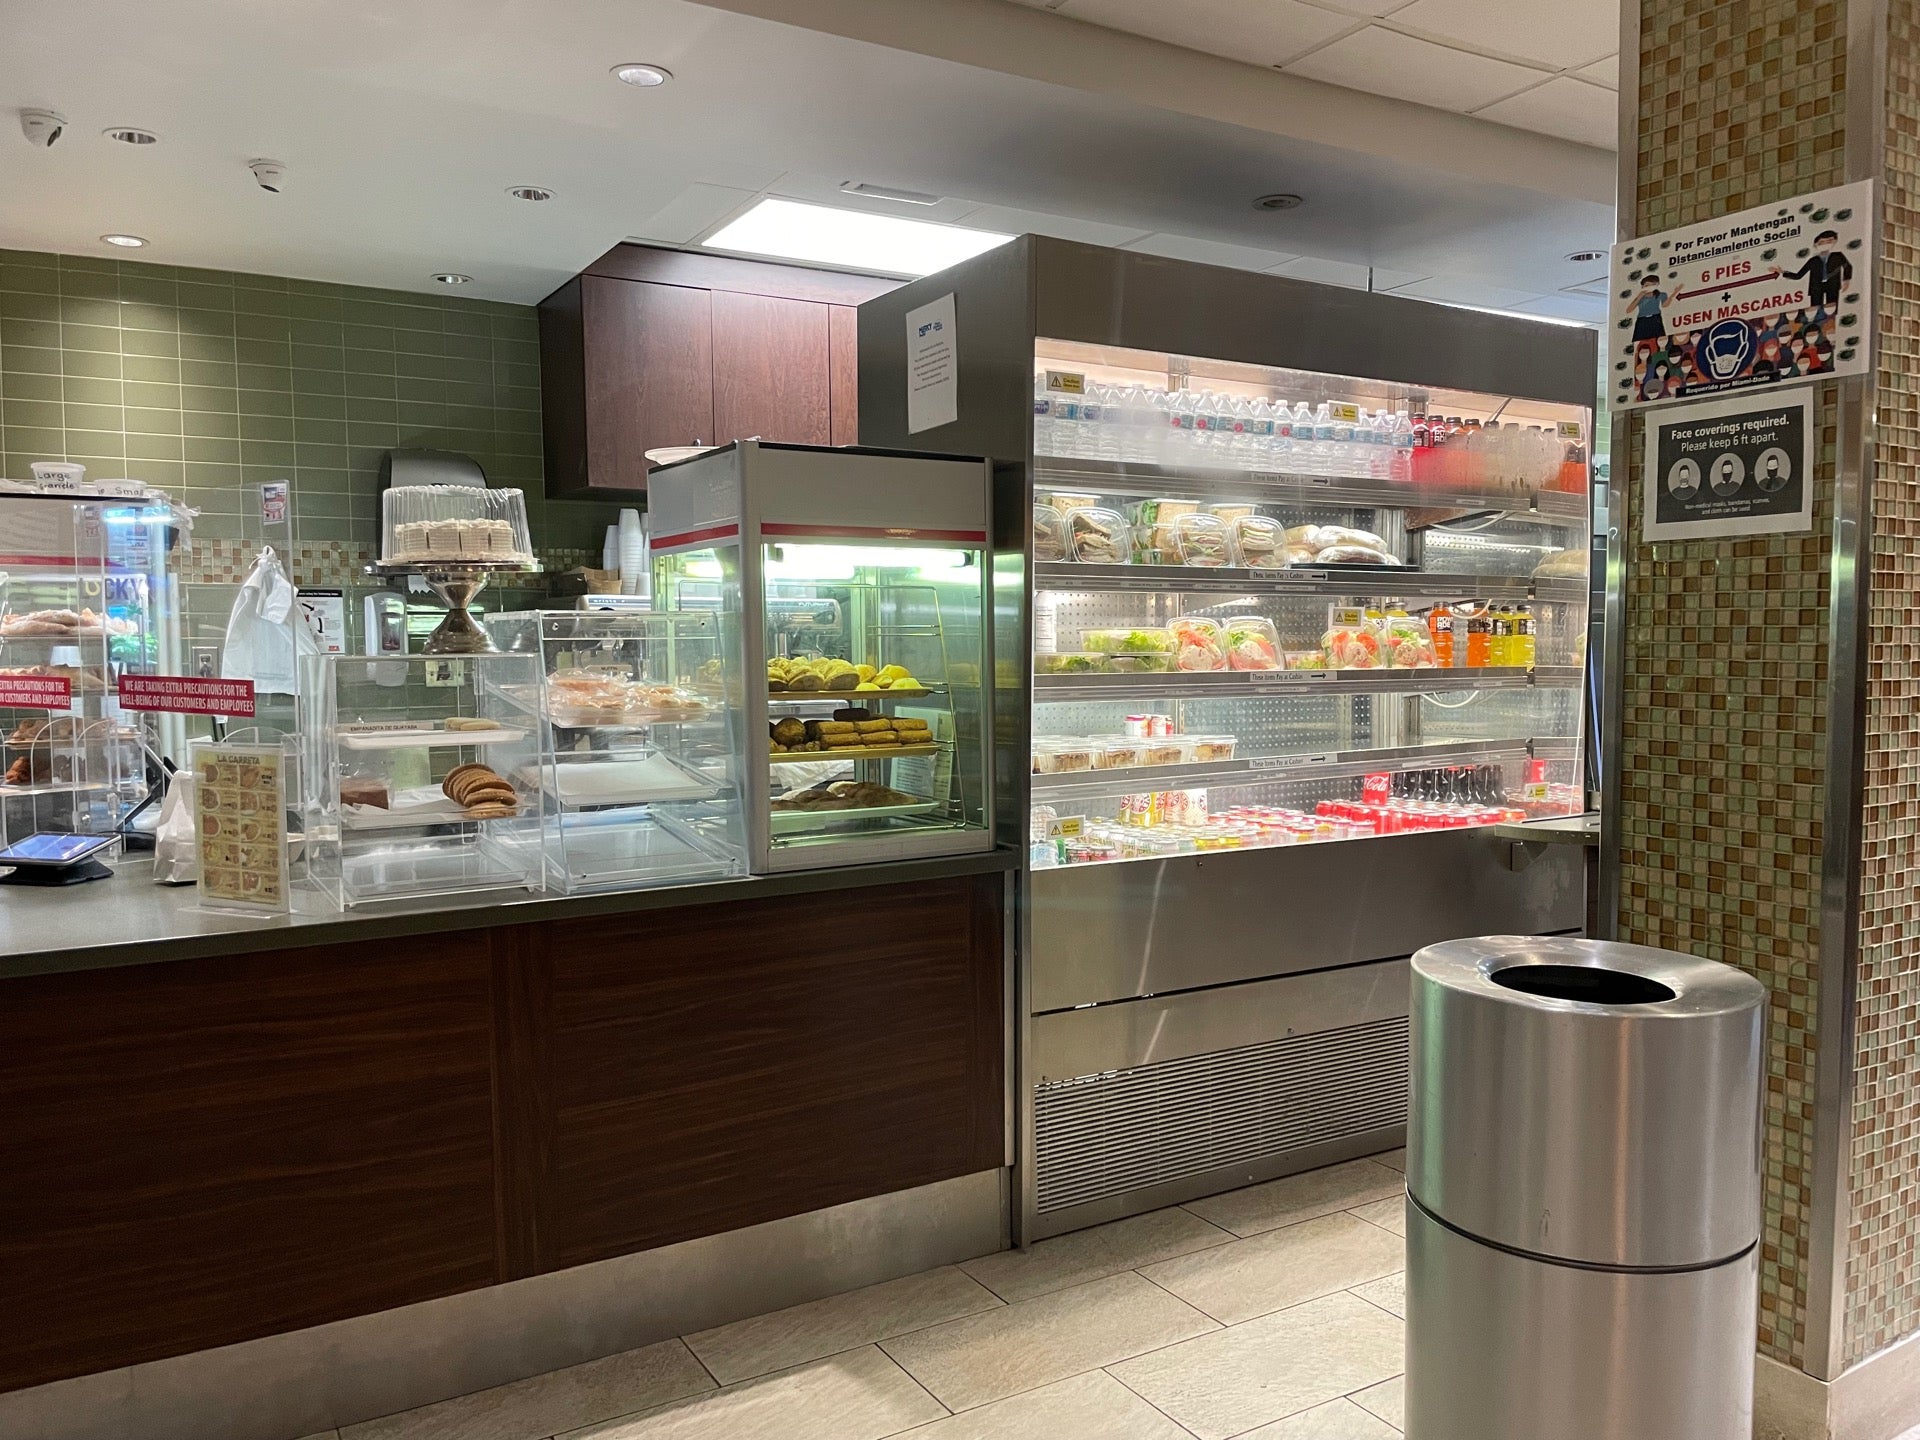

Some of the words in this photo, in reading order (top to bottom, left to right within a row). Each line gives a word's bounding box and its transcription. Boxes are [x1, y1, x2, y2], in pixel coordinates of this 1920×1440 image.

[1675, 241, 1693, 252] Por
[1697, 232, 1728, 246] Favor
[1730, 215, 1794, 238] Mantengan
[1669, 237, 1760, 266] Distanciamiento
[1764, 226, 1800, 242] Social
[1702, 271, 1710, 282] 6
[1716, 261, 1752, 280] PIES
[1672, 310, 1712, 328] USEN
[1718, 290, 1804, 318] MASCARAS
[1686, 384, 1718, 394] Requerido
[1671, 430, 1692, 440] Face
[1694, 423, 1740, 437] coverings
[1743, 414, 1790, 431] required.
[1681, 441, 1707, 452] Please
[1709, 438, 1730, 449] keep
[1733, 435, 1739, 446] 6
[1741, 434, 1748, 444] ft
[1751, 432, 1778, 445] apart.
[38, 472, 71, 481] Large
[13, 681, 44, 691] PRECAUTIONS
[45, 681, 54, 692] FOR
[55, 682, 65, 692] THE
[125, 680, 133, 691] WE
[134, 680, 144, 691] ARE
[146, 681, 164, 692] TAKING
[166, 682, 183, 693] EXTRA
[184, 683, 222, 695] PRECAUTIONS
[224, 685, 235, 696] FOR
[236, 685, 247, 696] THE
[5, 693, 31, 703] CUSTOMERS
[32, 694, 42, 704] AND
[43, 694, 70, 706] EMPLOYEES
[121, 694, 152, 706] WELL-BEING
[153, 696, 160, 706] OF
[161, 696, 172, 707] OUR
[173, 697, 206, 709] CUSTOMERS
[207, 698, 219, 710] AND
[221, 699, 253, 712] EMPLOYEES
[228, 756, 260, 764] CARRETA
